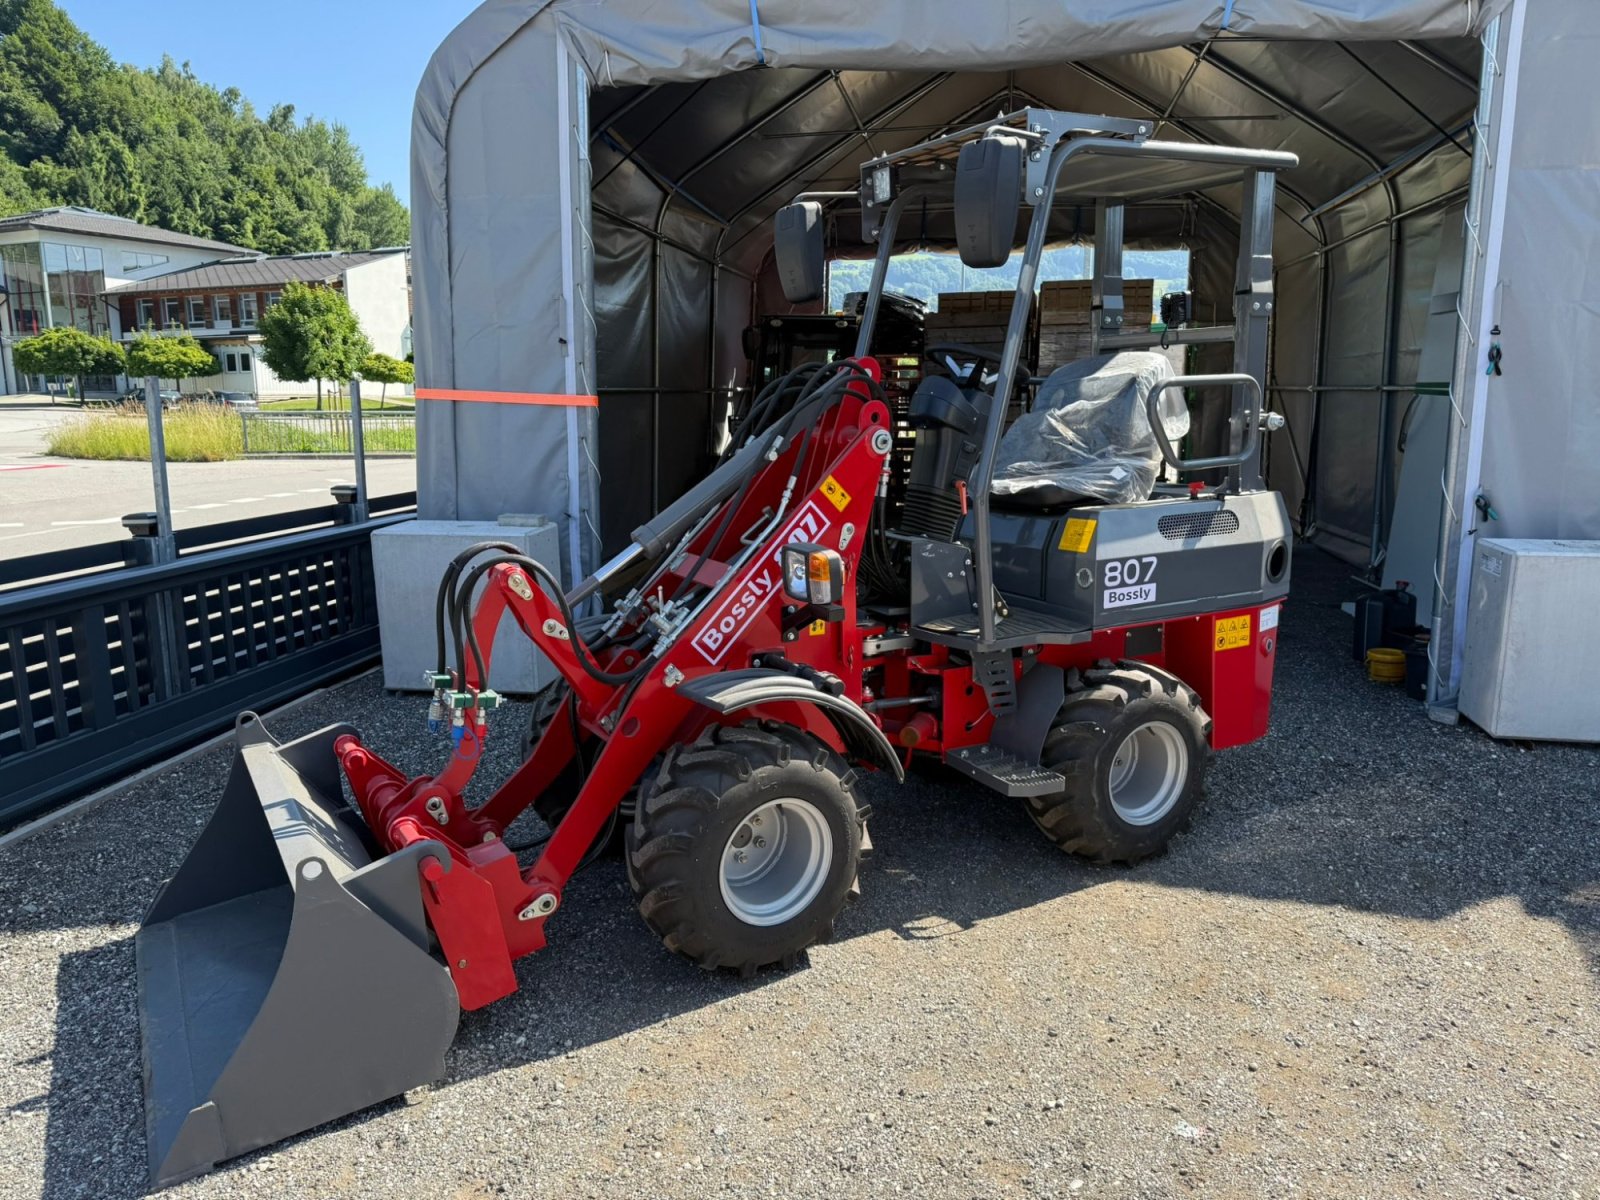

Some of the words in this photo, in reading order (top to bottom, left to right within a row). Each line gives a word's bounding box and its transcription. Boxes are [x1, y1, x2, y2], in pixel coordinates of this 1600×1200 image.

[702, 569, 772, 651] Bossly
[774, 513, 819, 567] 07
[1104, 556, 1158, 587] 807
[1109, 587, 1151, 604] Bossly
